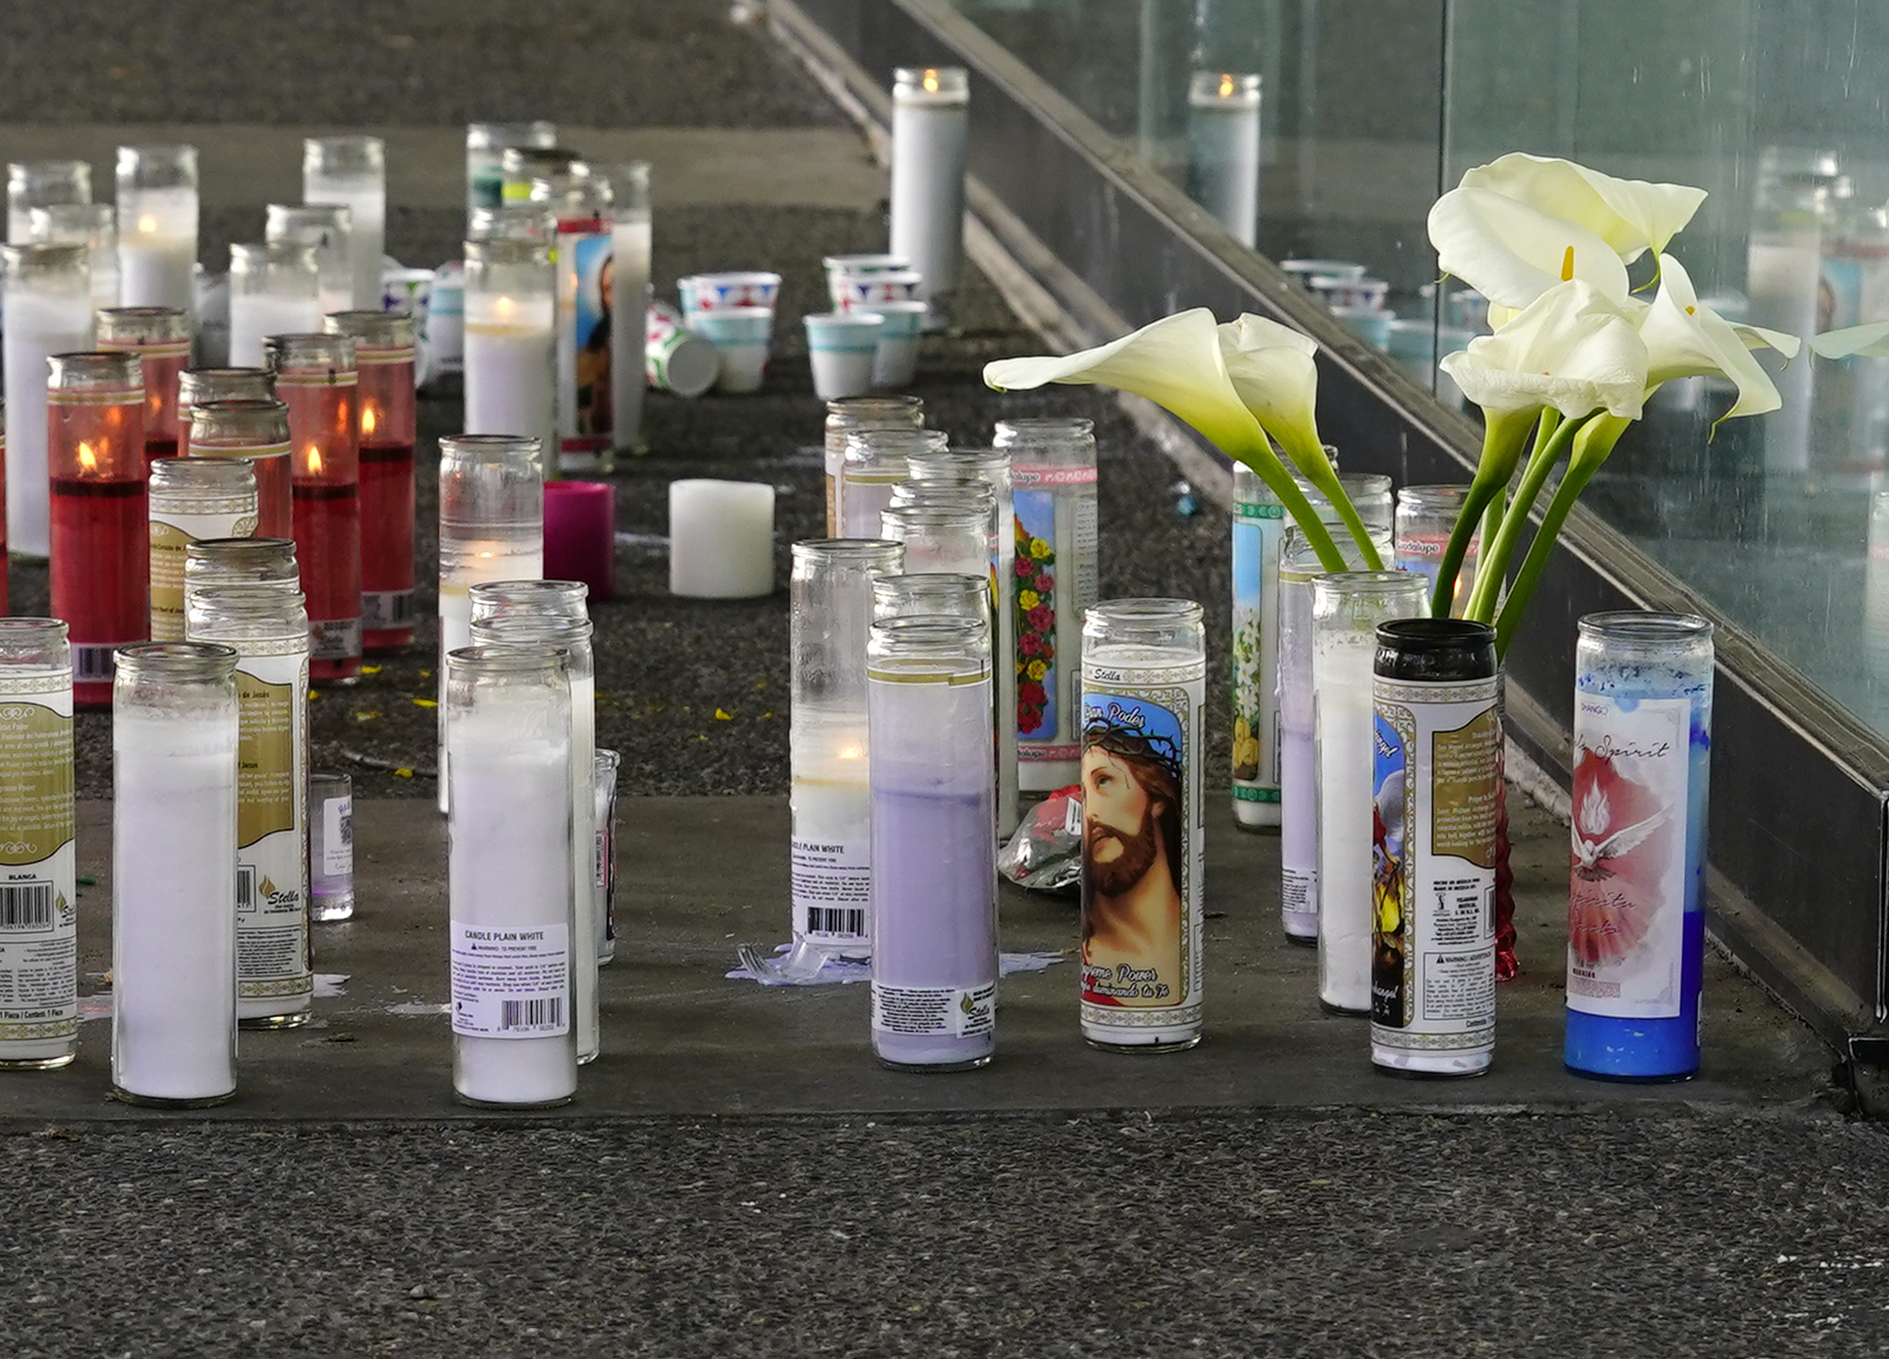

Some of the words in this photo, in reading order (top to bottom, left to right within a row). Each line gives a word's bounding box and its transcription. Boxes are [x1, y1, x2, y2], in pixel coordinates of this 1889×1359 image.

[1093, 668, 1121, 681] Stella
[1595, 734, 1670, 766] Spirit
[821, 845, 845, 854] WHITE
[8, 873, 37, 881] BLANCA
[464, 930, 491, 941] CANDLE
[493, 931, 518, 942] PLAIN
[519, 931, 544, 941] WHITE
